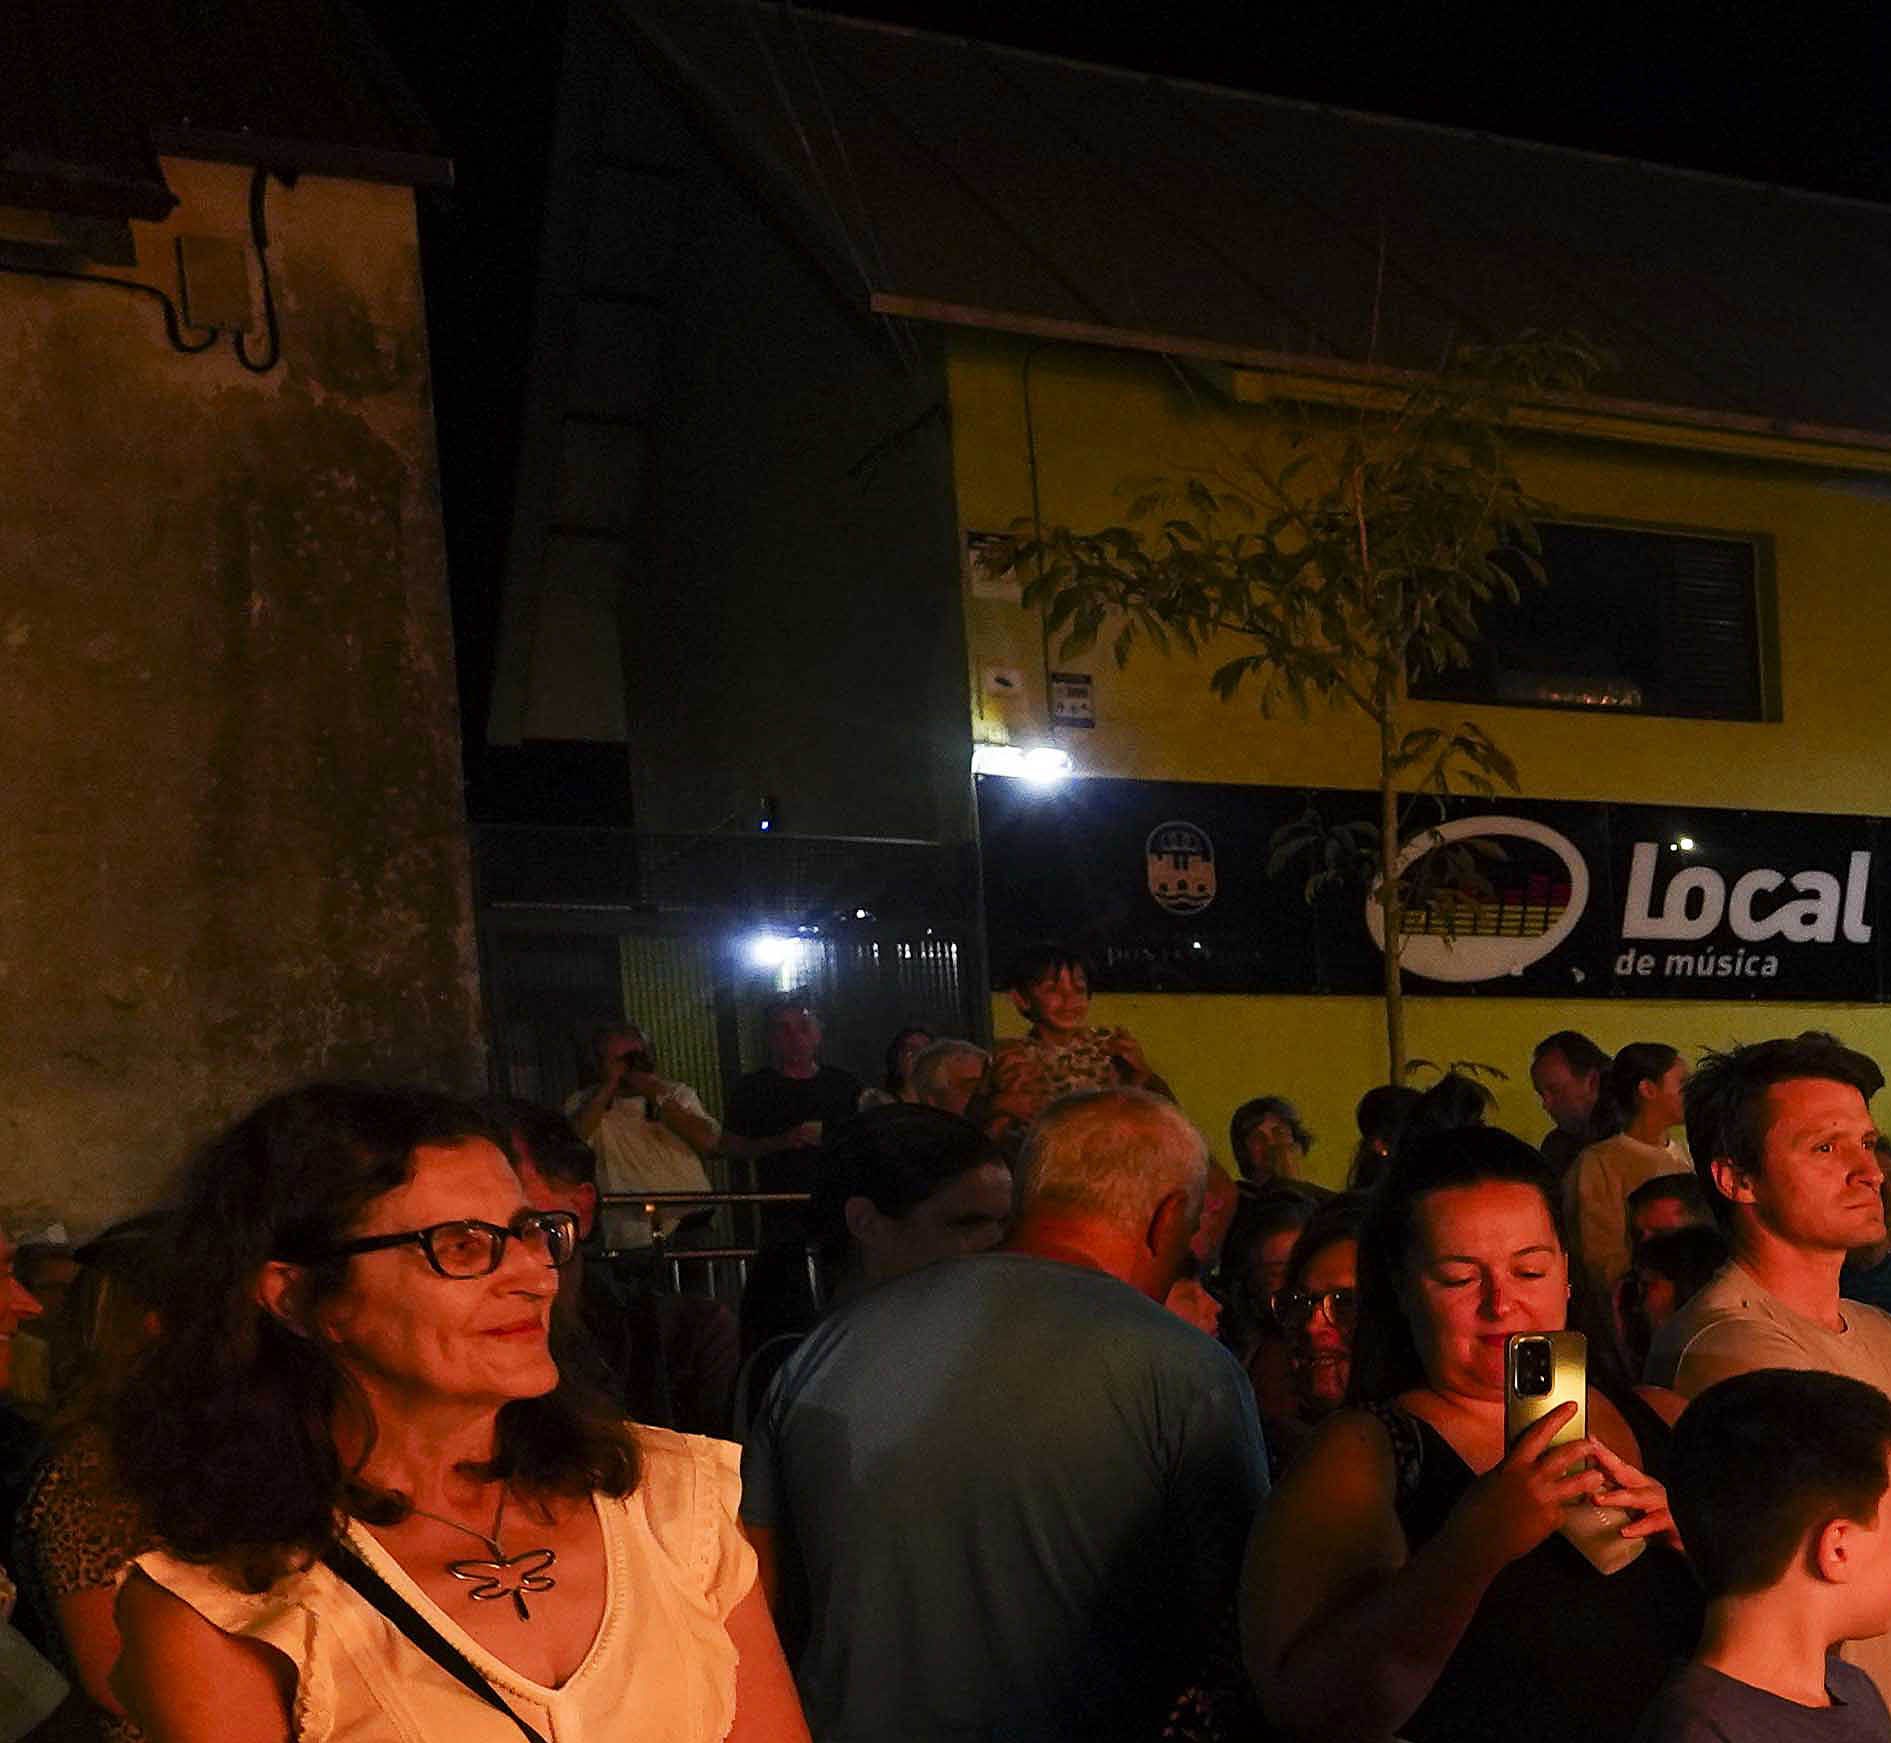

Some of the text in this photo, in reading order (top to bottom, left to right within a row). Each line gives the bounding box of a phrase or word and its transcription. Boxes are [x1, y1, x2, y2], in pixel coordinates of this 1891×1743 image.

[1622, 841, 1873, 944] Local
[1614, 945, 1779, 977] de música
